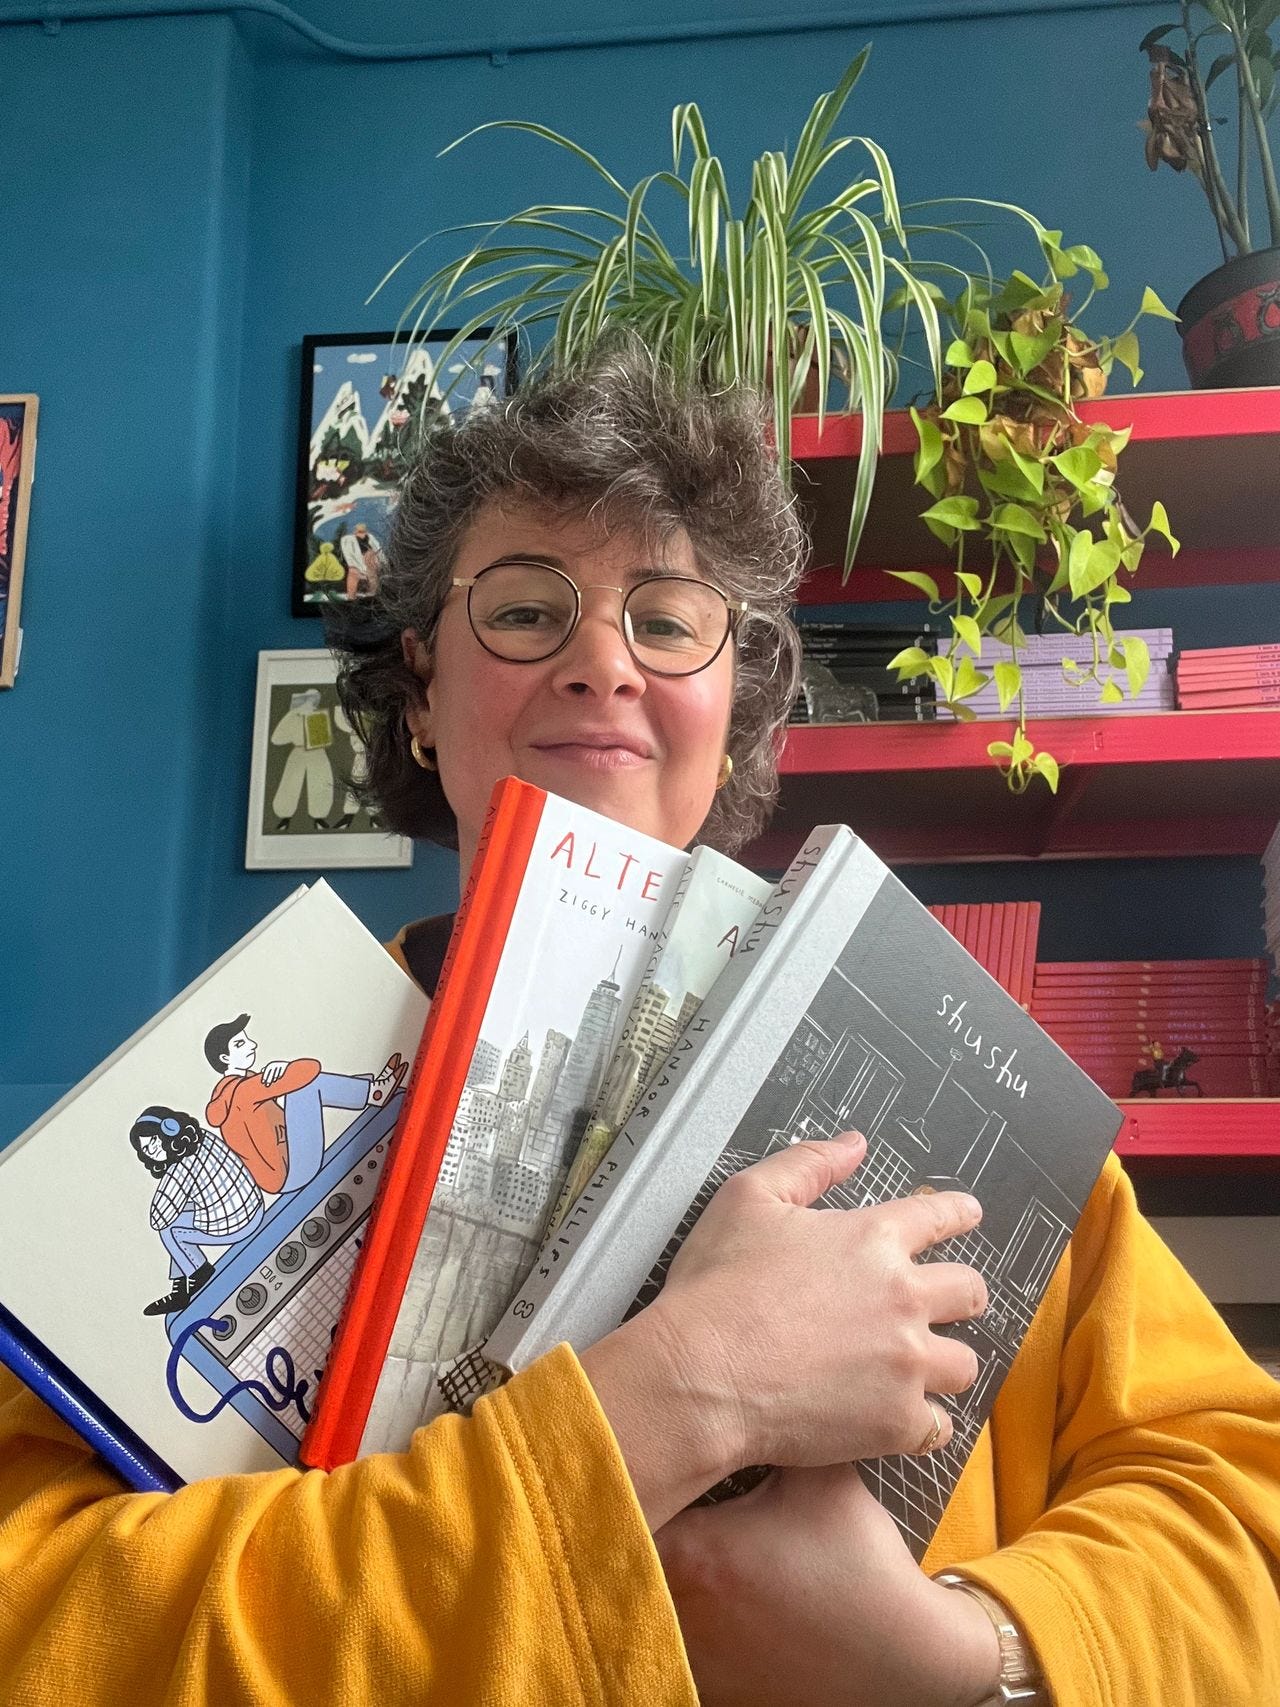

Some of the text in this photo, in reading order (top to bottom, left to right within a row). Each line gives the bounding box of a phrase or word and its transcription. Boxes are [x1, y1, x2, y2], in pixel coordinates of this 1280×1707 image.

[551, 831, 664, 902] ALTE
[559, 888, 660, 941] ZIGGY HAN
[636, 1017, 711, 1118] HANAOR
[540, 1161, 619, 1279] PHILLIPS
